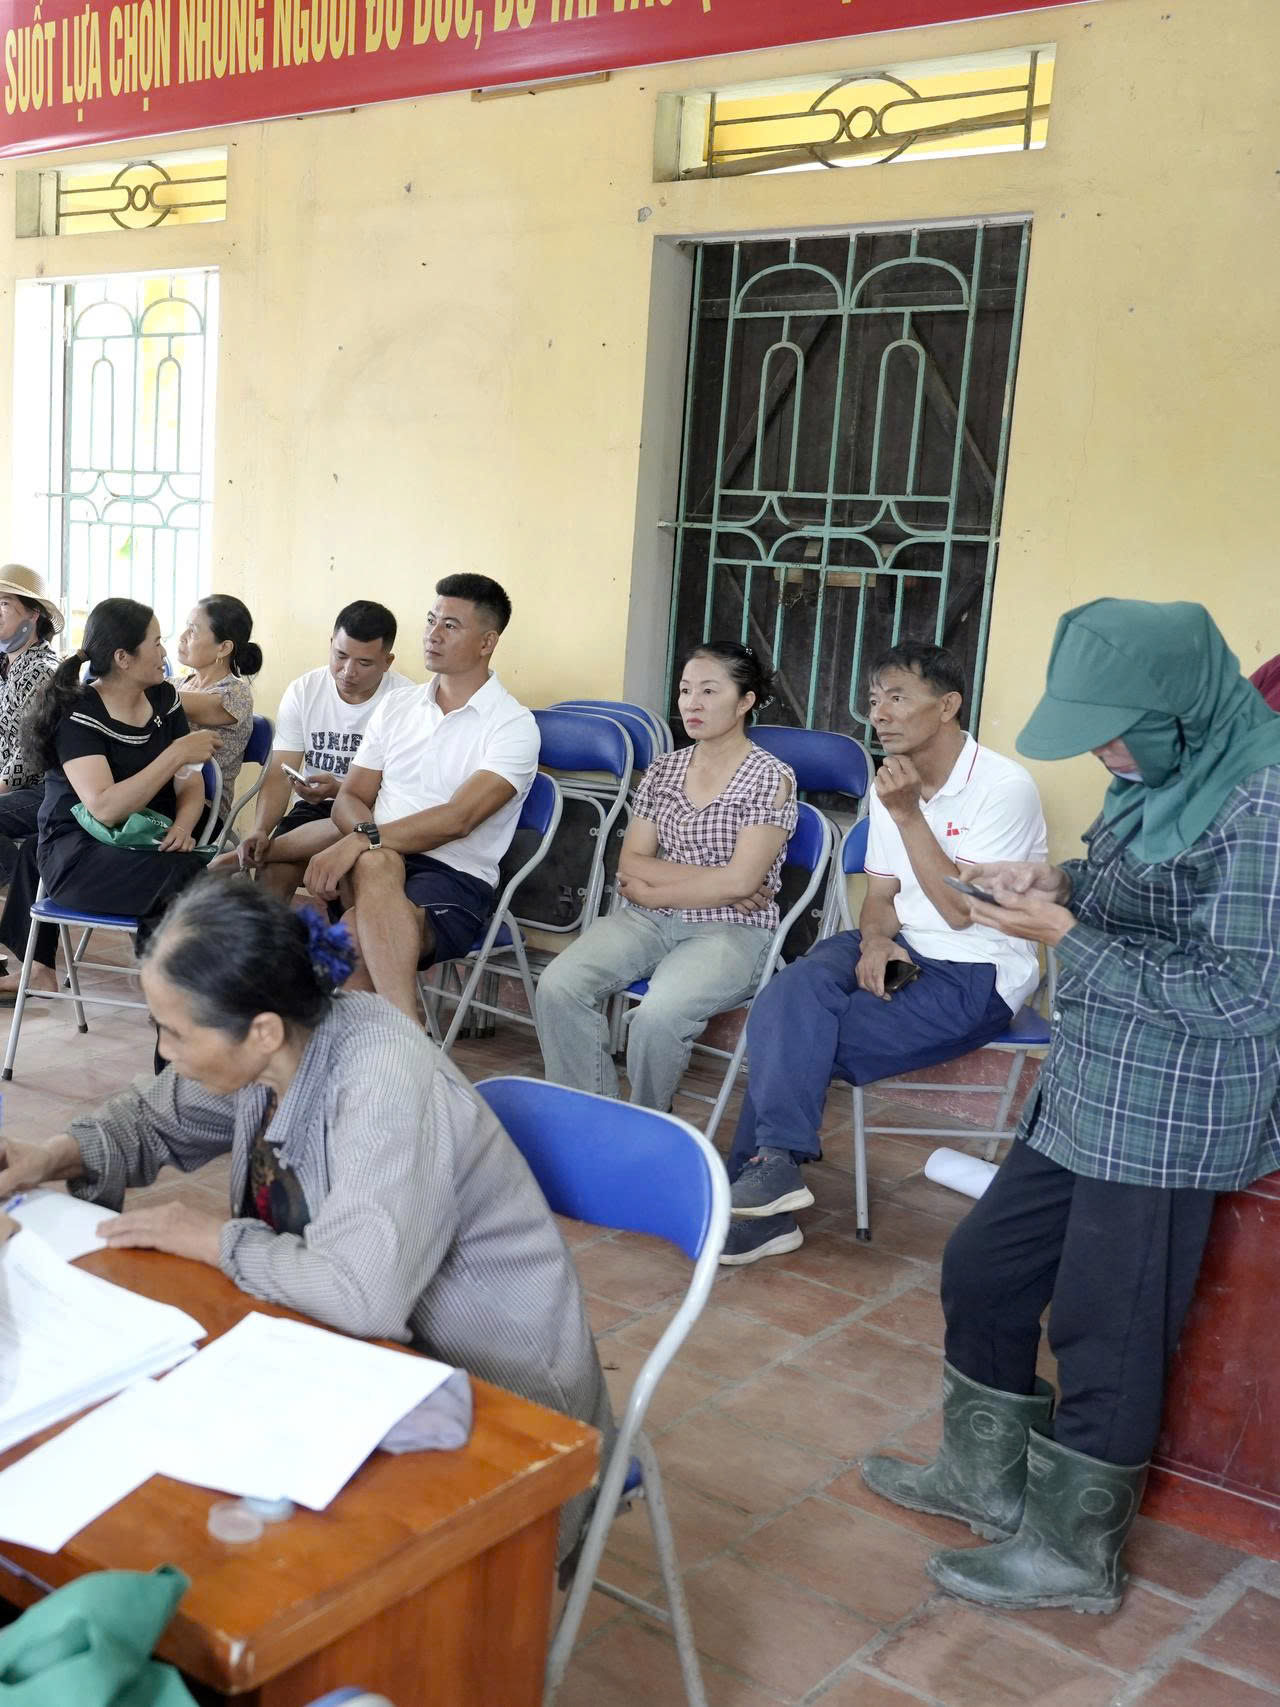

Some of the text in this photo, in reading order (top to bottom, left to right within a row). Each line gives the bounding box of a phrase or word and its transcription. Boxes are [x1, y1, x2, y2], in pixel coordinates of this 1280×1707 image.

[5, 0, 56, 115] SUỐT
[63, 3, 102, 122] LỰA
[109, 0, 171, 112] CHỌN
